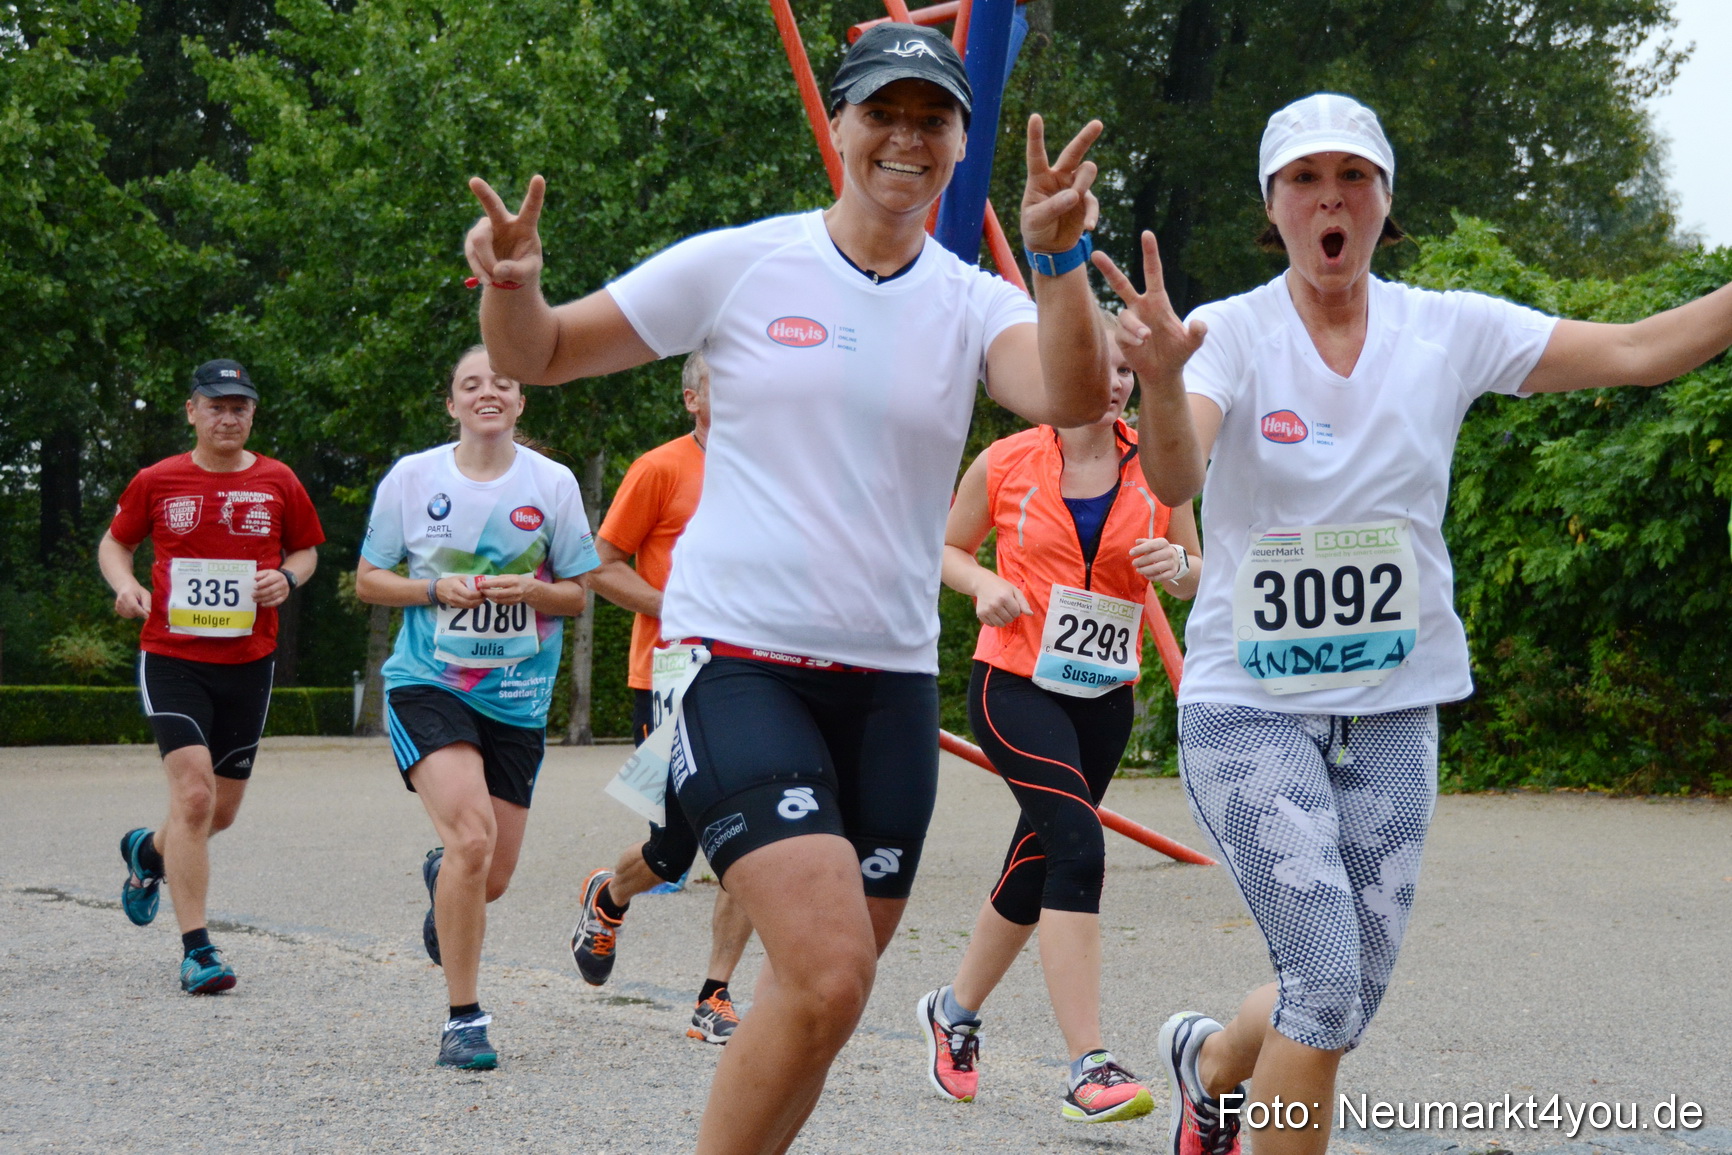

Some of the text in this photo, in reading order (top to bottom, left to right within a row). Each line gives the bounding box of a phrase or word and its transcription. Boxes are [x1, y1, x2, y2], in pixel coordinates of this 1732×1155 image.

[772, 321, 823, 342] Hervis
[838, 335, 857, 343] ONLINE
[837, 344, 857, 352] MOBILE
[1263, 417, 1304, 437] Hervis
[168, 506, 197, 514] WIEDER
[169, 500, 196, 508] IMMER
[170, 513, 194, 522] NEU
[427, 525, 452, 533] PARTL
[1315, 527, 1400, 551] BOCK
[1315, 547, 1403, 559] inspired by smart concepts
[187, 578, 240, 607] 335
[1253, 562, 1403, 632] 3092
[1059, 598, 1093, 610] NeuerMarkt
[1098, 599, 1135, 618] BOCK
[193, 613, 231, 627] Holger
[448, 597, 527, 633] 2080
[1053, 613, 1130, 665] 2293
[471, 642, 505, 656] Julia
[752, 649, 769, 658] new
[770, 651, 802, 664] balance
[1243, 635, 1406, 679] ANDREA
[1062, 664, 1118, 685] Susanne
[498, 688, 537, 698] Stadtlauf
[714, 822, 744, 848] Schröder
